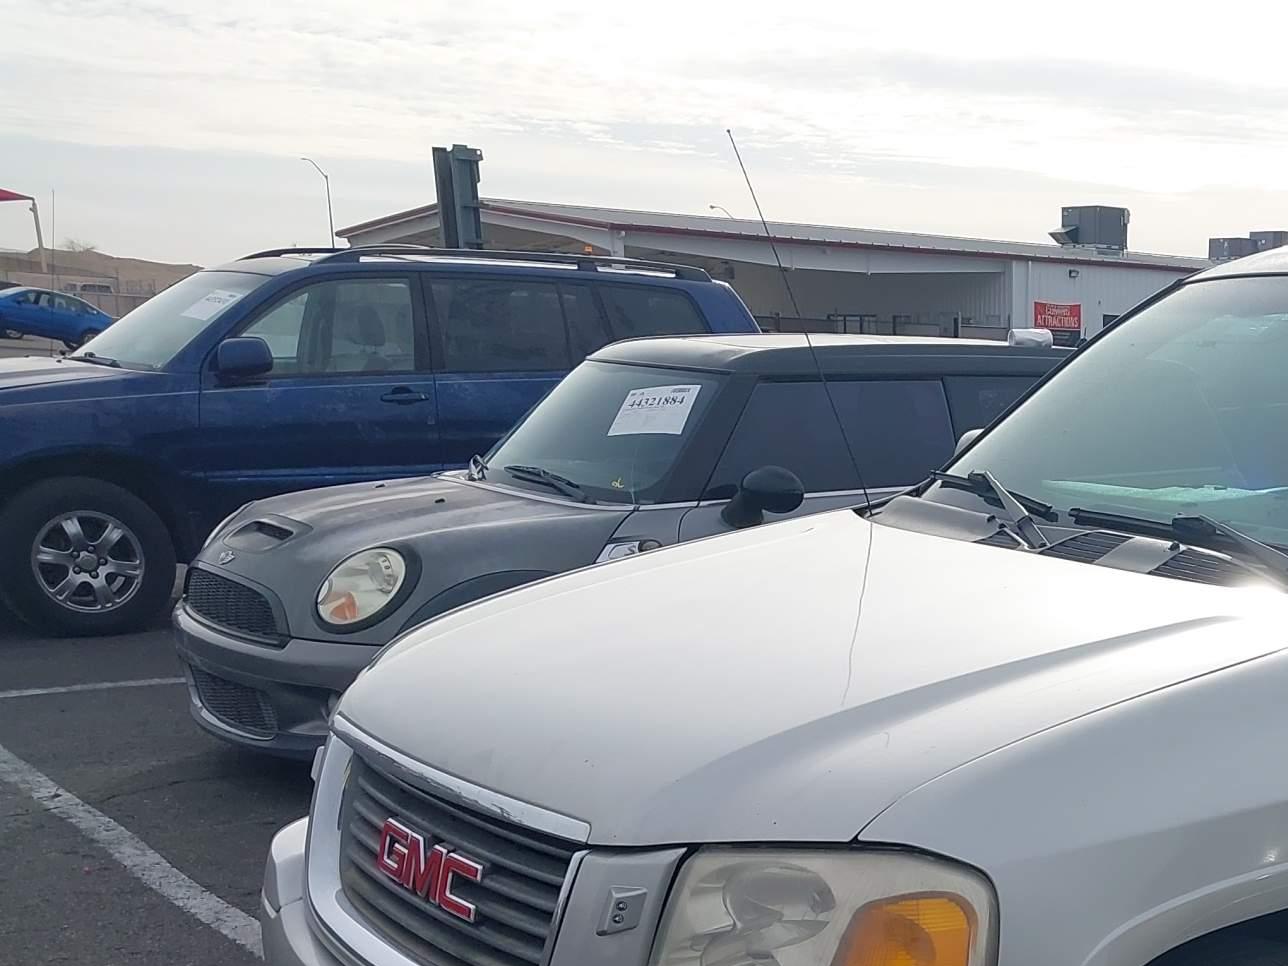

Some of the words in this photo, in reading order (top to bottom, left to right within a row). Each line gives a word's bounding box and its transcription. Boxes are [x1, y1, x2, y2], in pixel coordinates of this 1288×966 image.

[1037, 315, 1079, 328] ATTRACTIONS
[628, 396, 686, 408] 44321884
[376, 817, 484, 923] GMC
